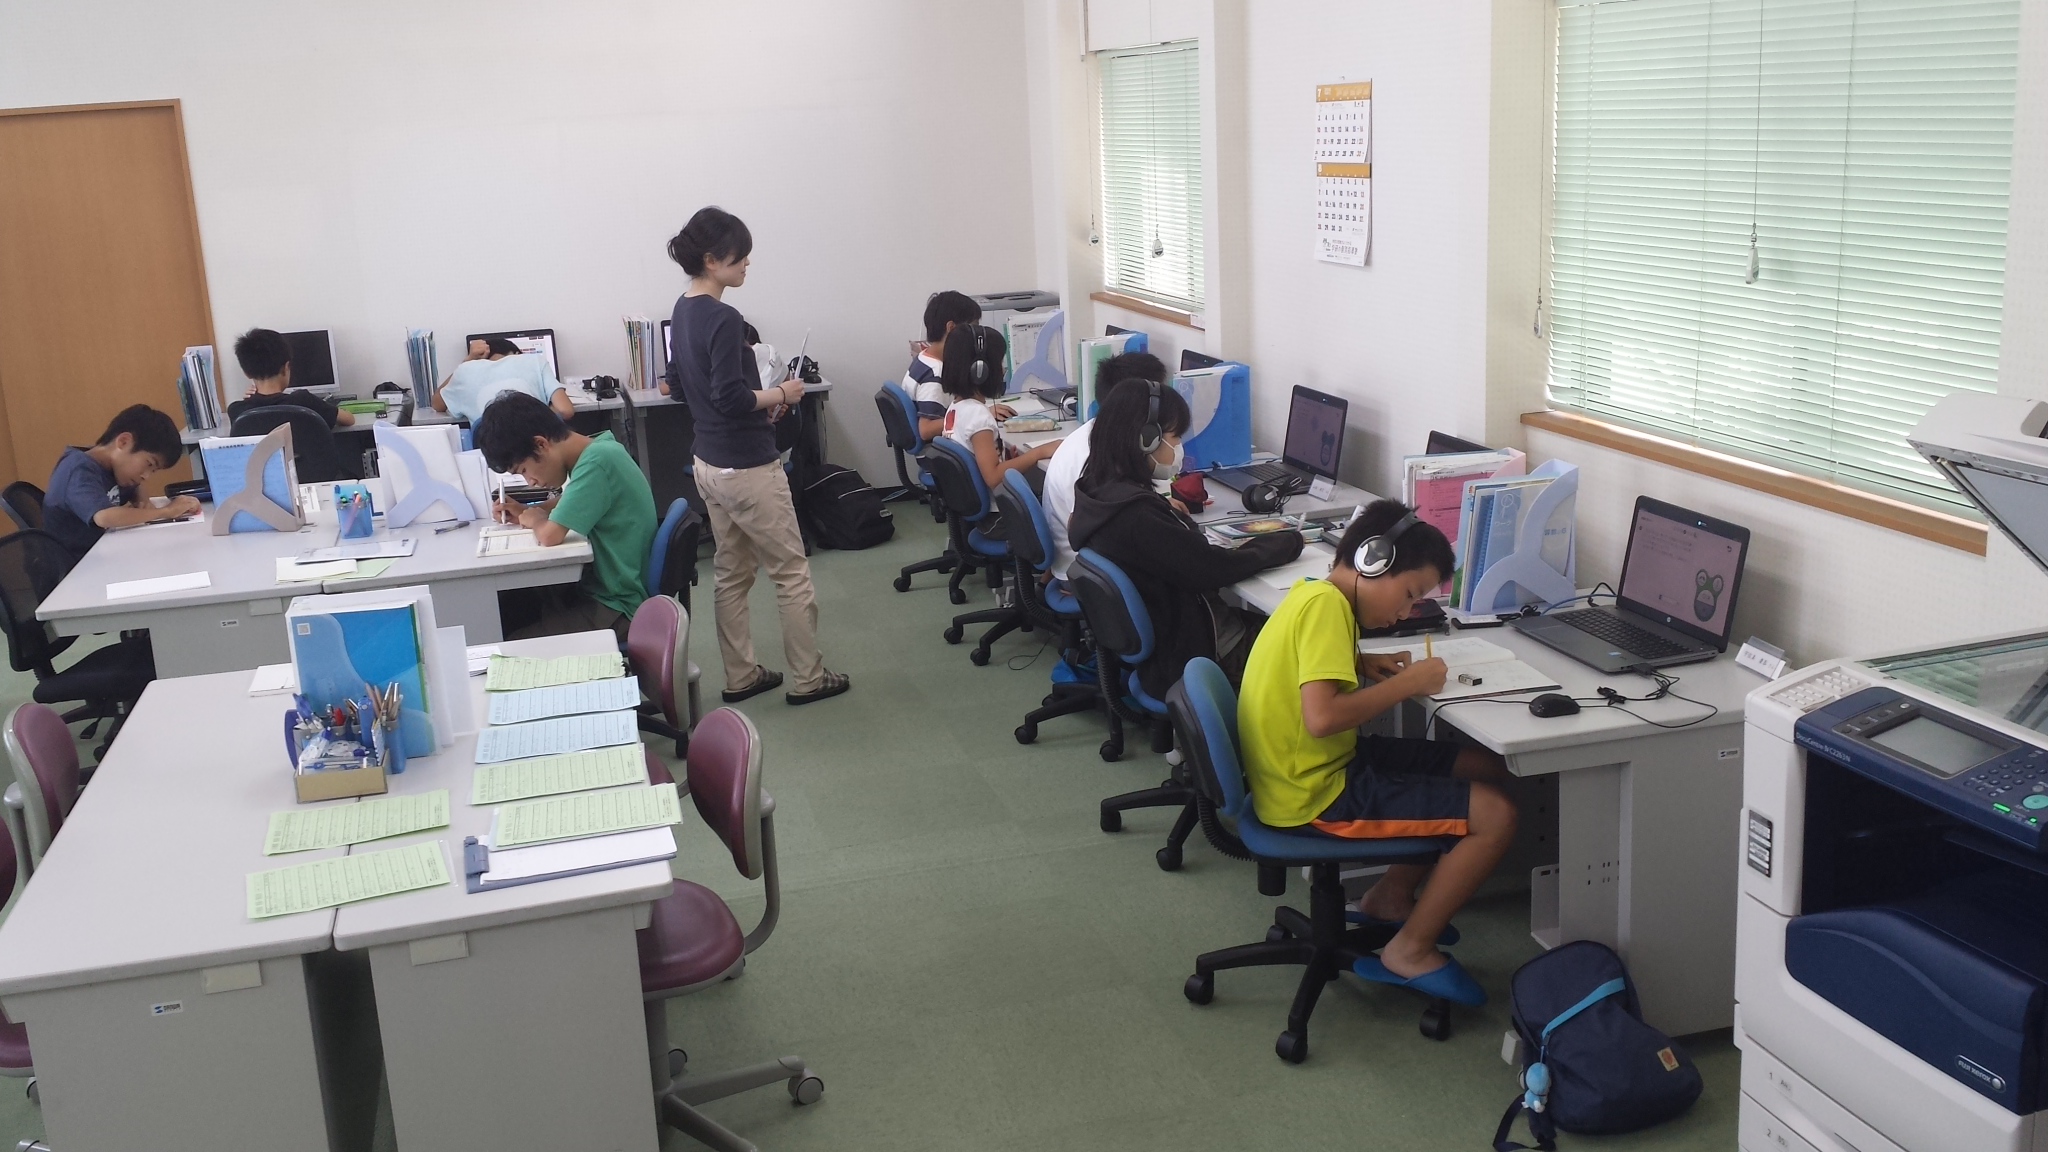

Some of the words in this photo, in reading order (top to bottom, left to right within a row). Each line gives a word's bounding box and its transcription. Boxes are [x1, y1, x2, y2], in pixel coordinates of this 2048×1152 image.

[1318, 88, 1322, 98] 7
[1318, 164, 1322, 172] 8
[1769, 1072, 1772, 1080] 1
[1767, 1128, 1772, 1138] 2
